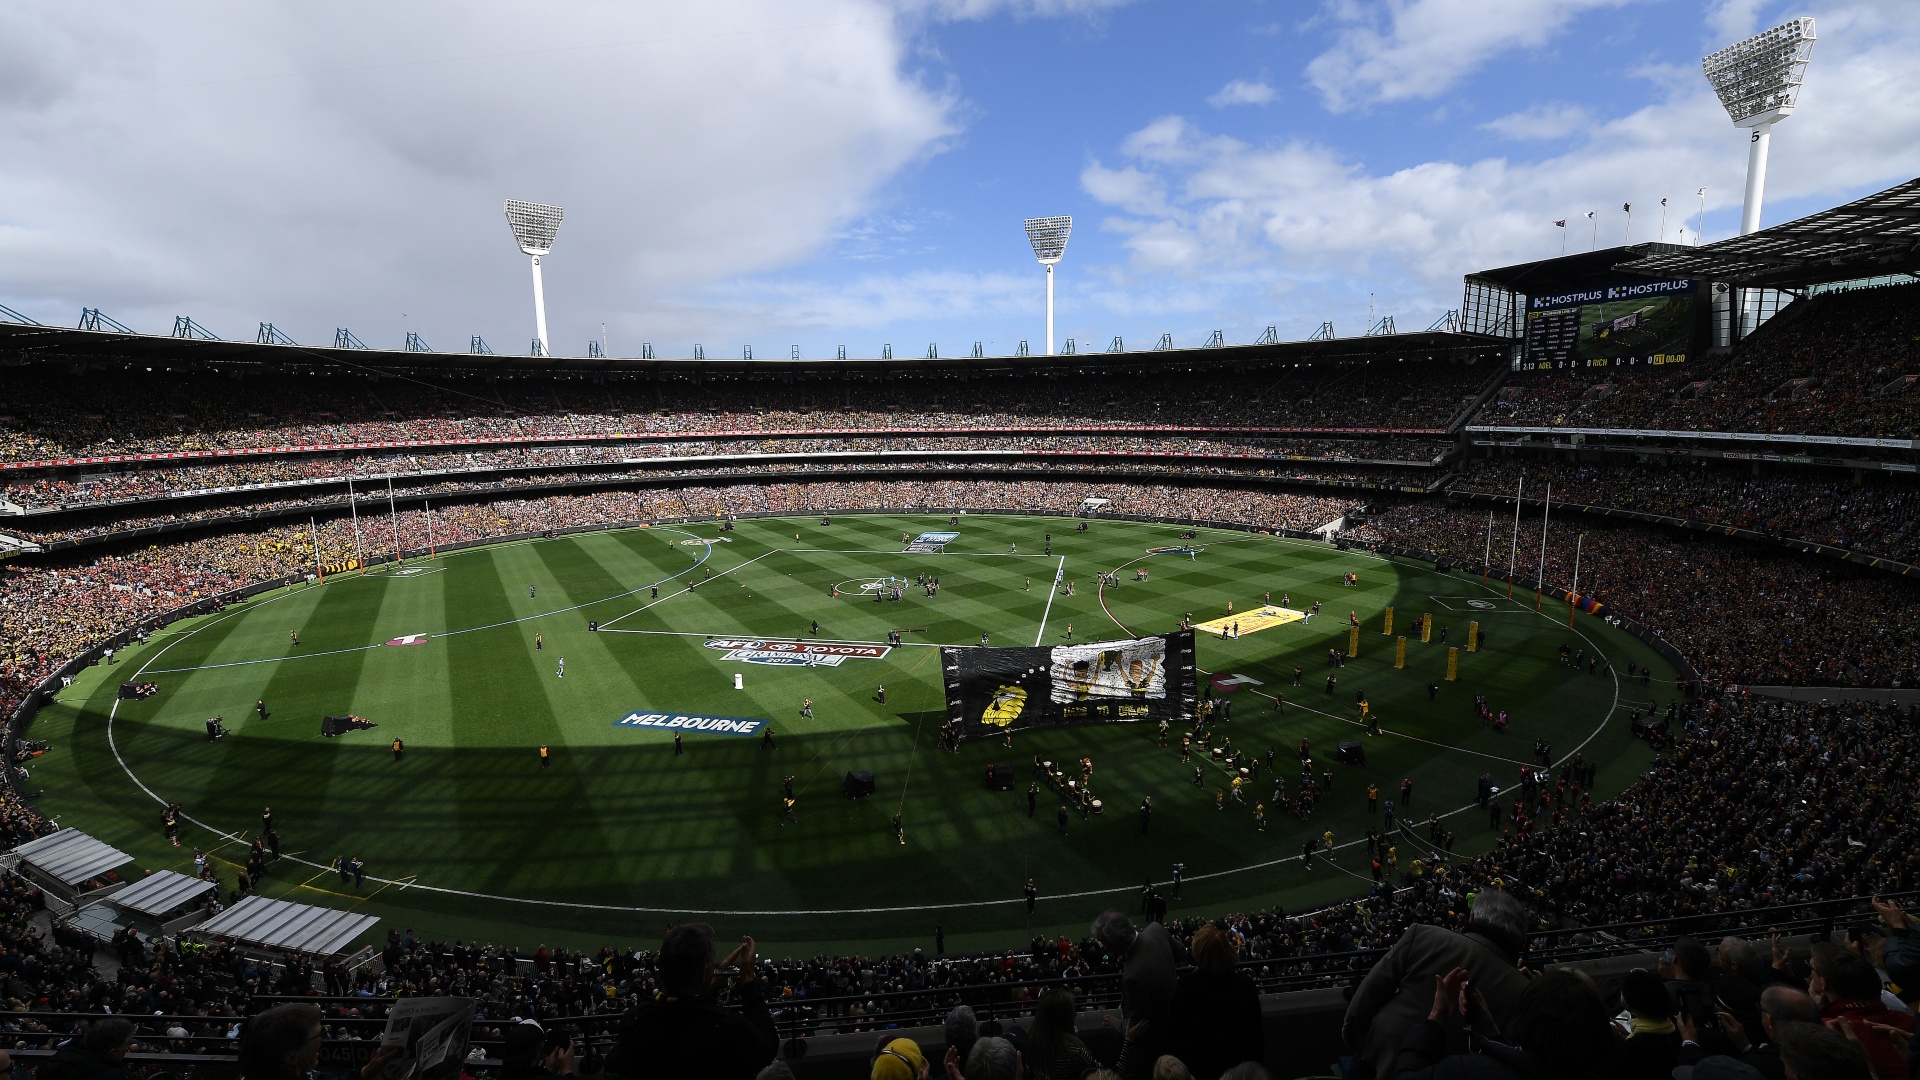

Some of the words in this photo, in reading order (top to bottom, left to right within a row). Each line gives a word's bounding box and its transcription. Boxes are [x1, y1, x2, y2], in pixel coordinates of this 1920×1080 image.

[1751, 130, 1760, 142] 5
[1629, 279, 1689, 295] HOSTPLUS
[1551, 290, 1602, 304] HOSTPLUS
[1538, 361, 1552, 370] ADEL
[1592, 358, 1608, 367] RICH
[1666, 354, 1686, 363] 00:00
[714, 640, 762, 649] AFL
[803, 646, 878, 655] TOYOTA
[620, 713, 760, 733] MELBOURNE
[320, 1047, 351, 1062] Q45
